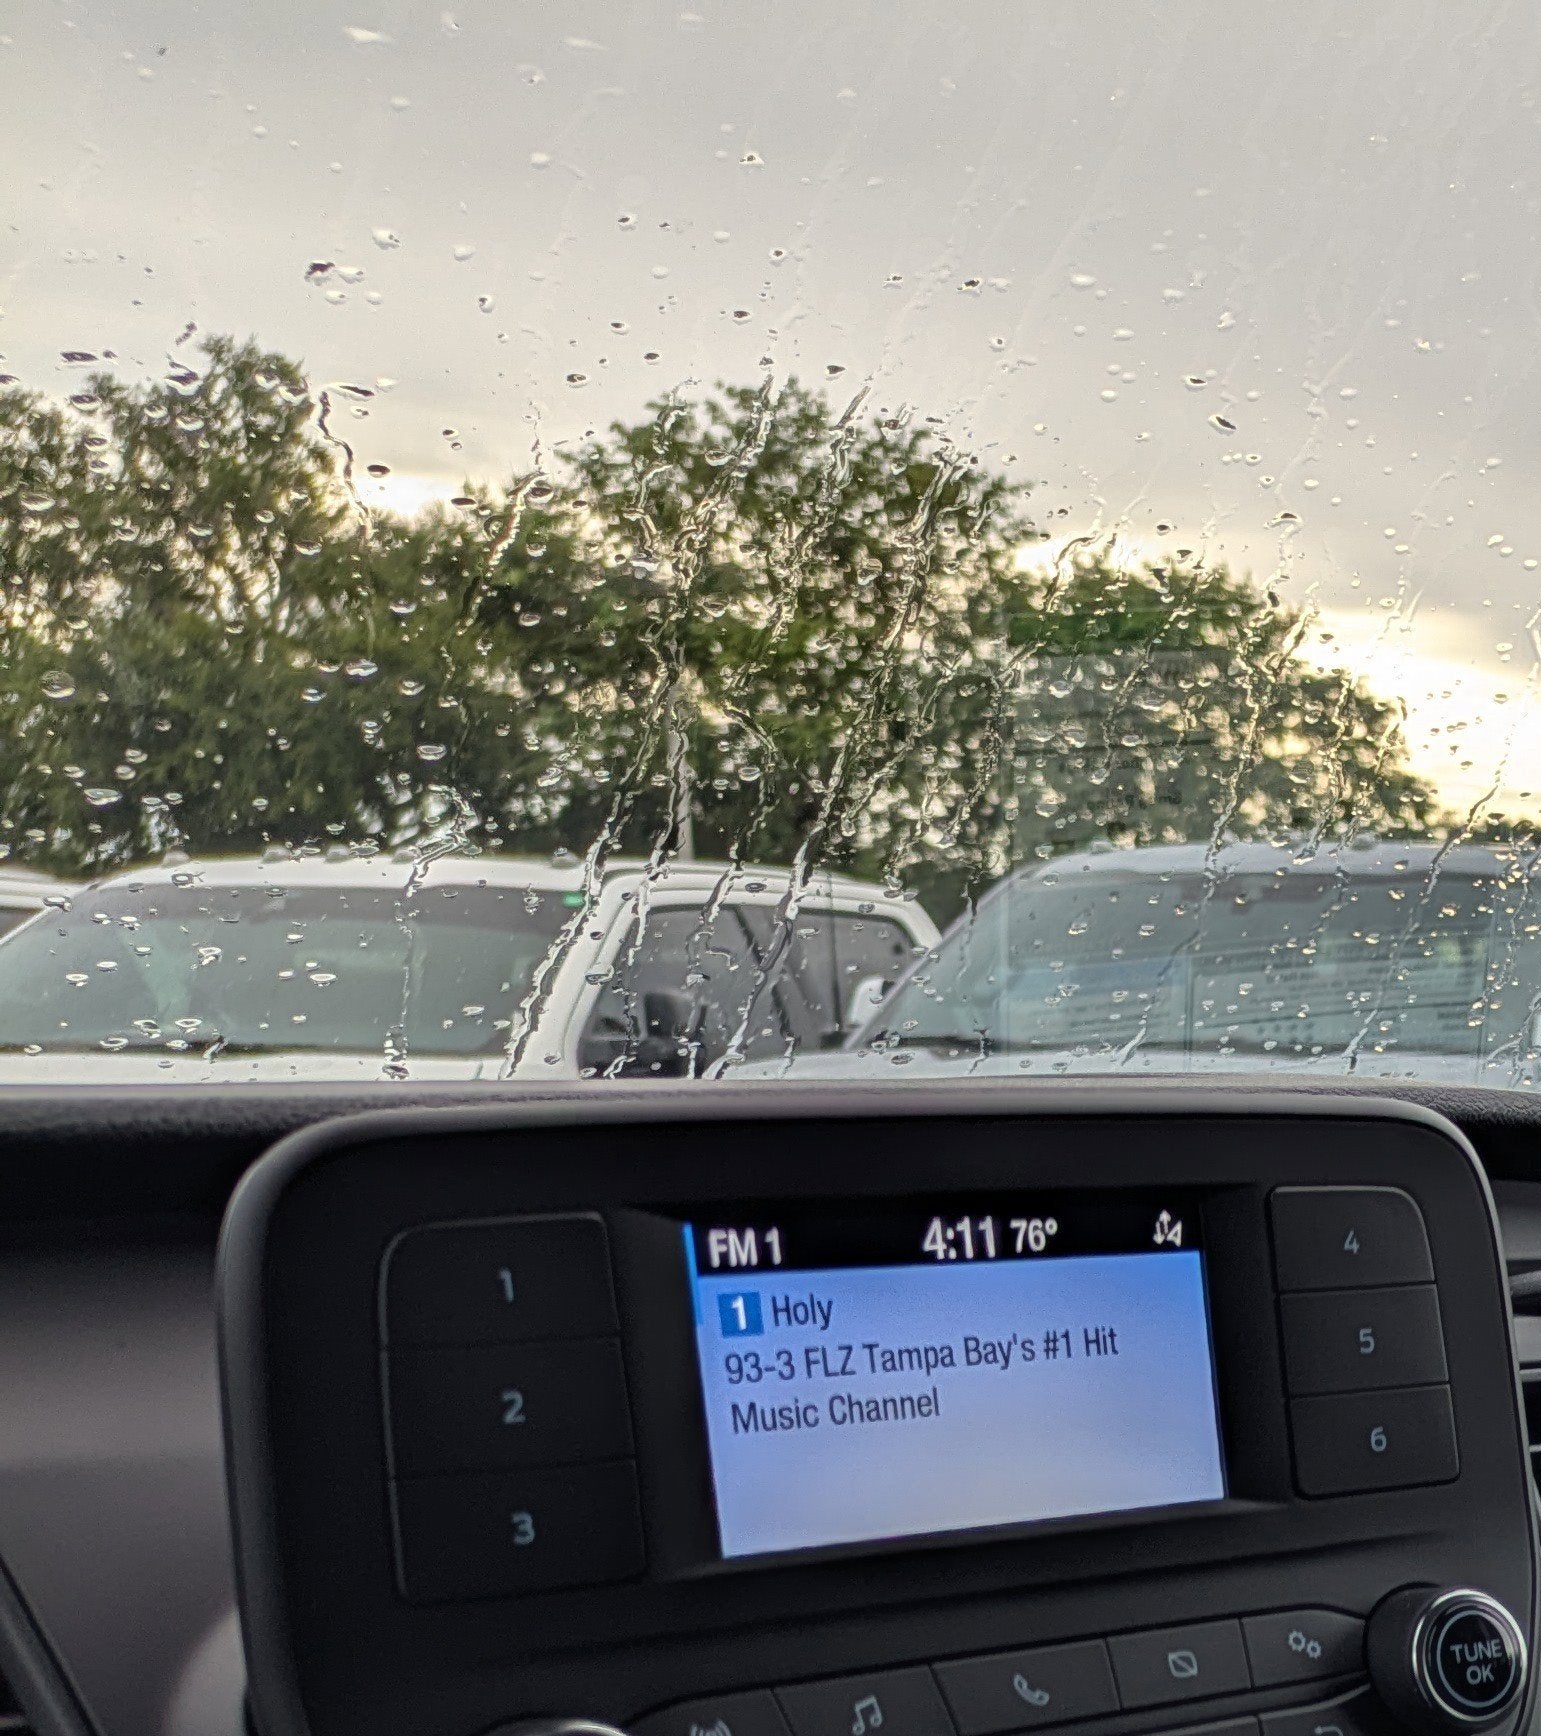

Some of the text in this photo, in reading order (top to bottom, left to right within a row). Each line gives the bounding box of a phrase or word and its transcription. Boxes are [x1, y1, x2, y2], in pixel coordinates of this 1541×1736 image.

[708, 1226, 782, 1269] FM 1
[922, 1215, 1058, 1260] 4:11 76°
[1344, 1230, 1360, 1254] 4
[499, 1267, 514, 1301] 1
[731, 1292, 834, 1332] 1 Holy
[724, 1325, 1119, 1385] 93-3 FLZ Tampa Bay's #1 Hit
[1359, 1328, 1376, 1354] 5
[501, 1389, 527, 1425] 2
[731, 1385, 941, 1435] Music Channel
[1370, 1426, 1388, 1453] 6
[511, 1511, 537, 1547] 3
[1449, 1637, 1503, 1665] TUNE
[1465, 1662, 1495, 1686] OK
